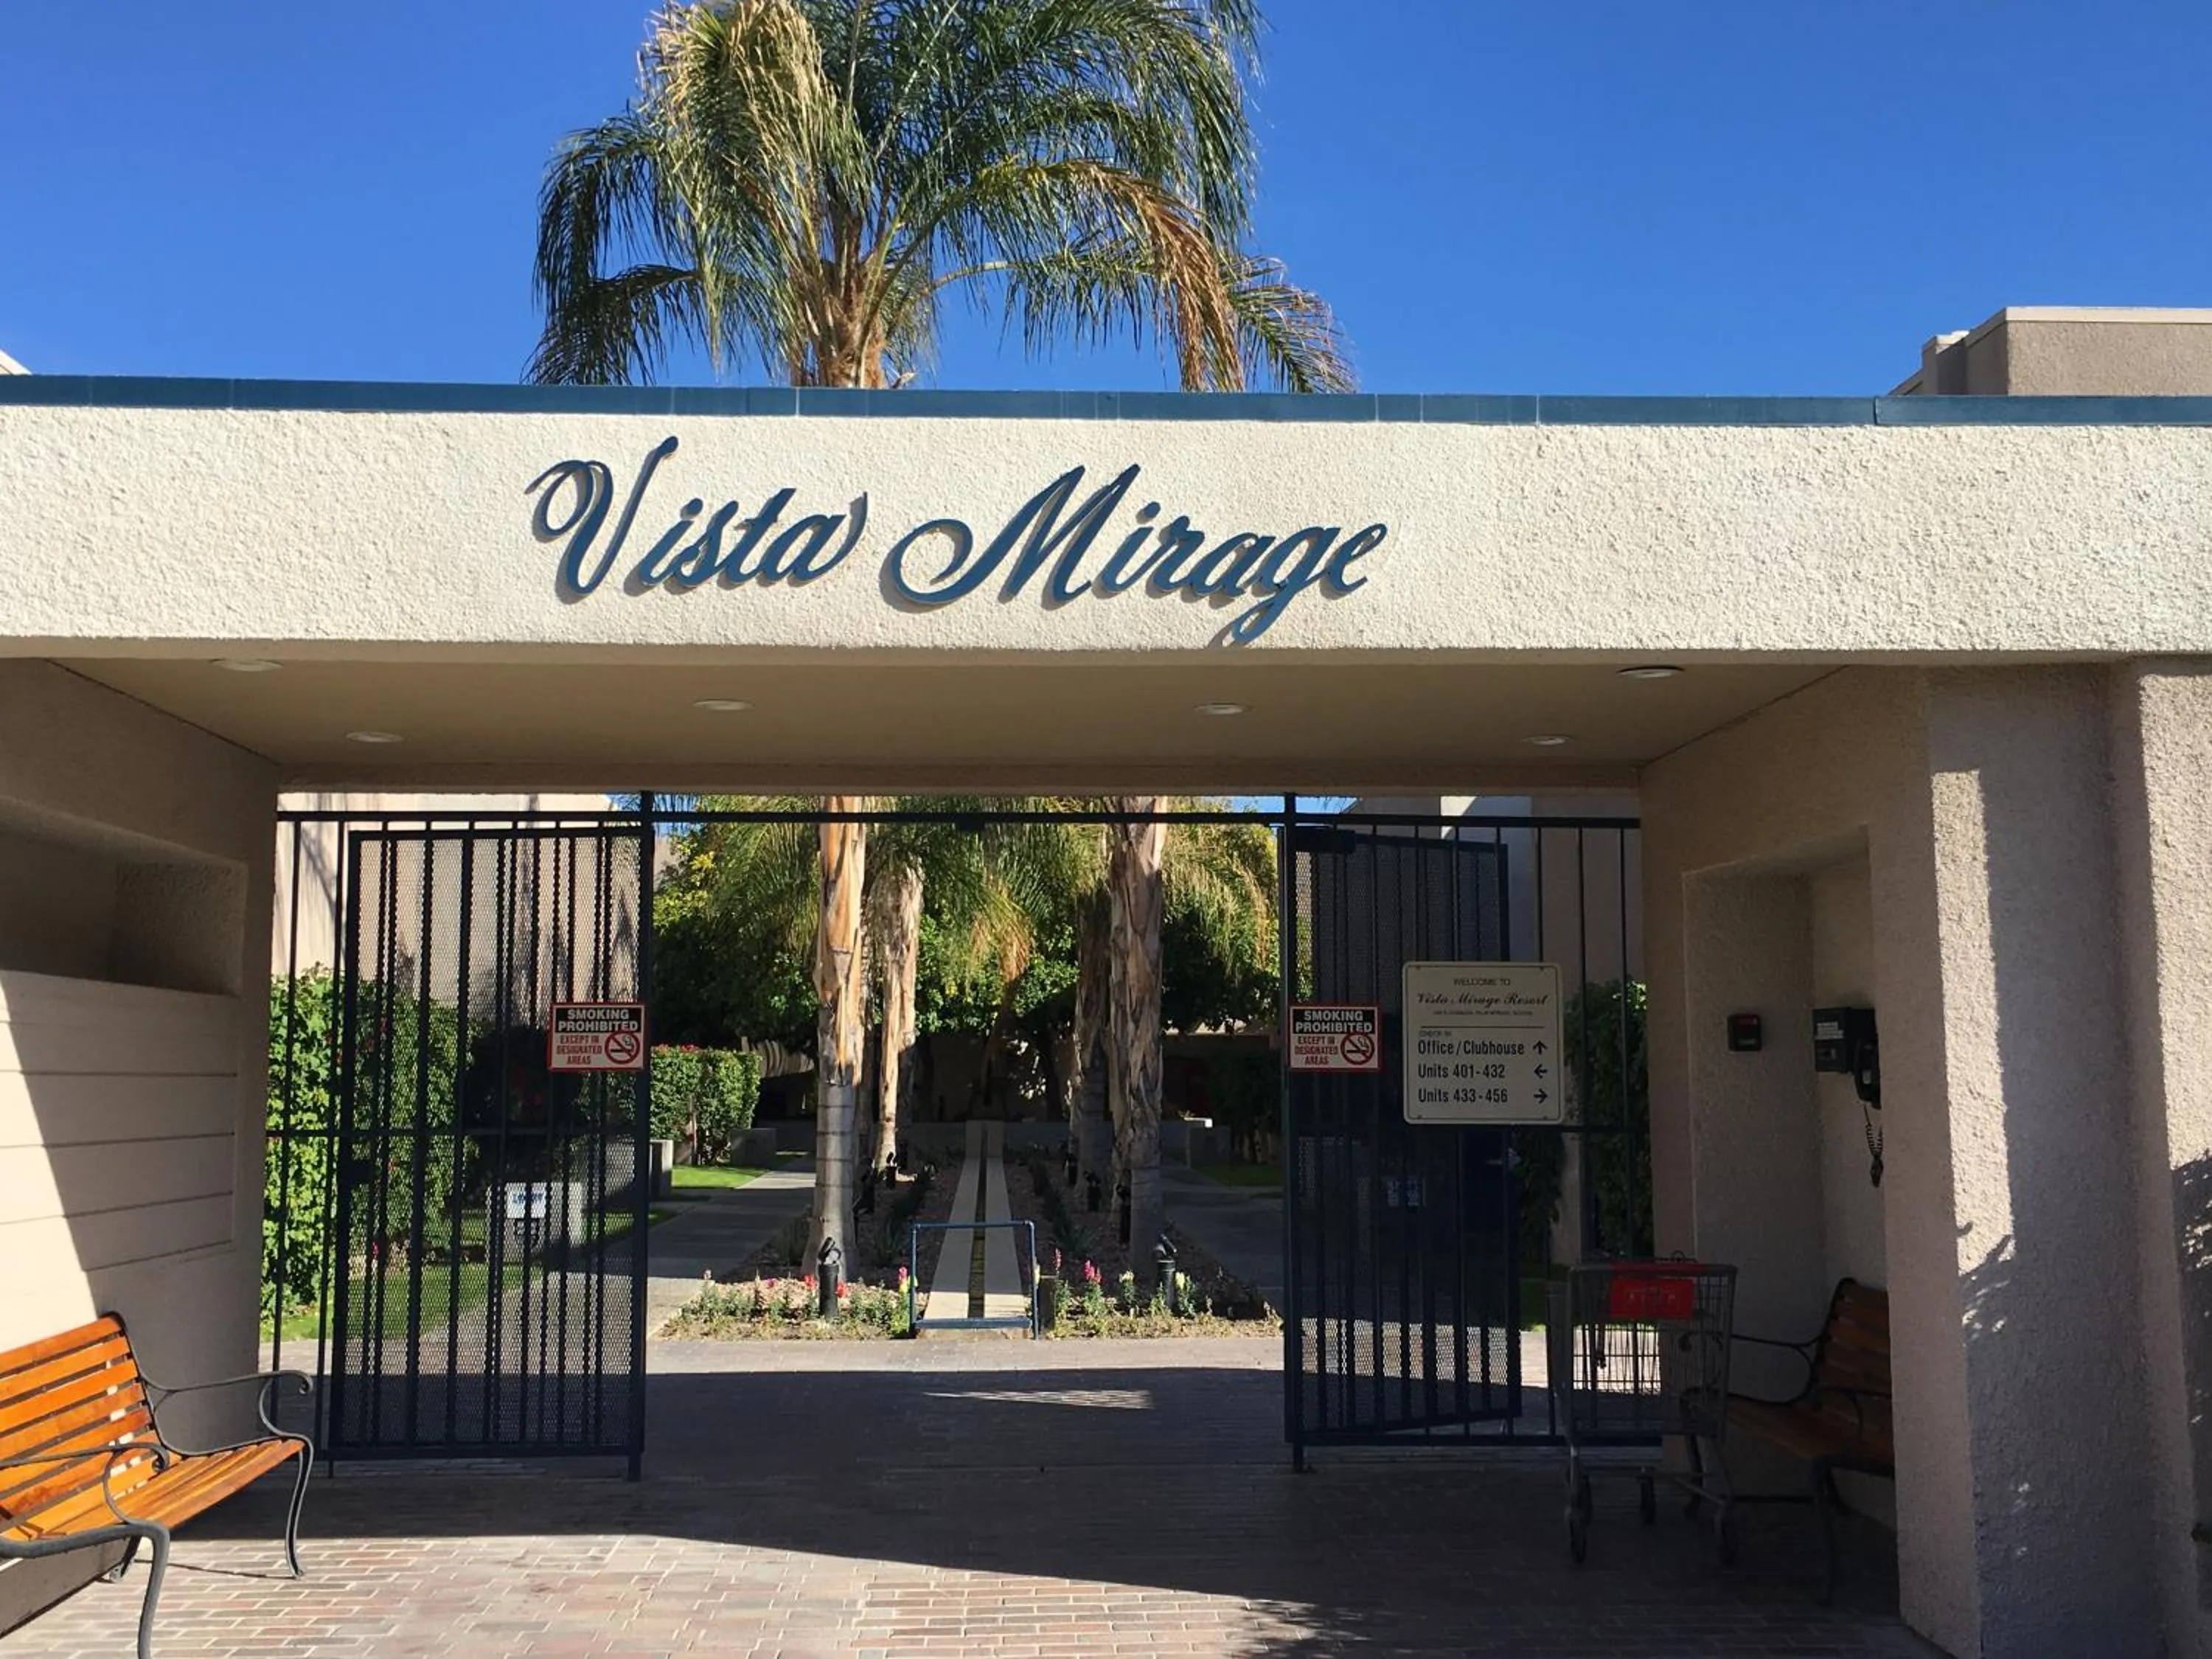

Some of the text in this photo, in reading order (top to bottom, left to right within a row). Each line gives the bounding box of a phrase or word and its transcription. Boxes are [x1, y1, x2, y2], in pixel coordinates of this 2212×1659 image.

[523, 435, 1390, 649] Vista Mirage
[1453, 978, 1511, 986] WELCOME TO
[1417, 991, 1549, 1008] Vista Mirage Resort
[567, 1009, 630, 1019] SMOKING
[1304, 1010, 1363, 1021] SMOKING
[557, 1020, 639, 1032] PROHIBITED
[1295, 1021, 1372, 1032] PROHIBITED
[560, 1034, 589, 1044] EXCEPT
[1298, 1036, 1326, 1045] EXCEPT
[1418, 1064, 1449, 1079] Units
[1418, 1088, 1449, 1102] Units
